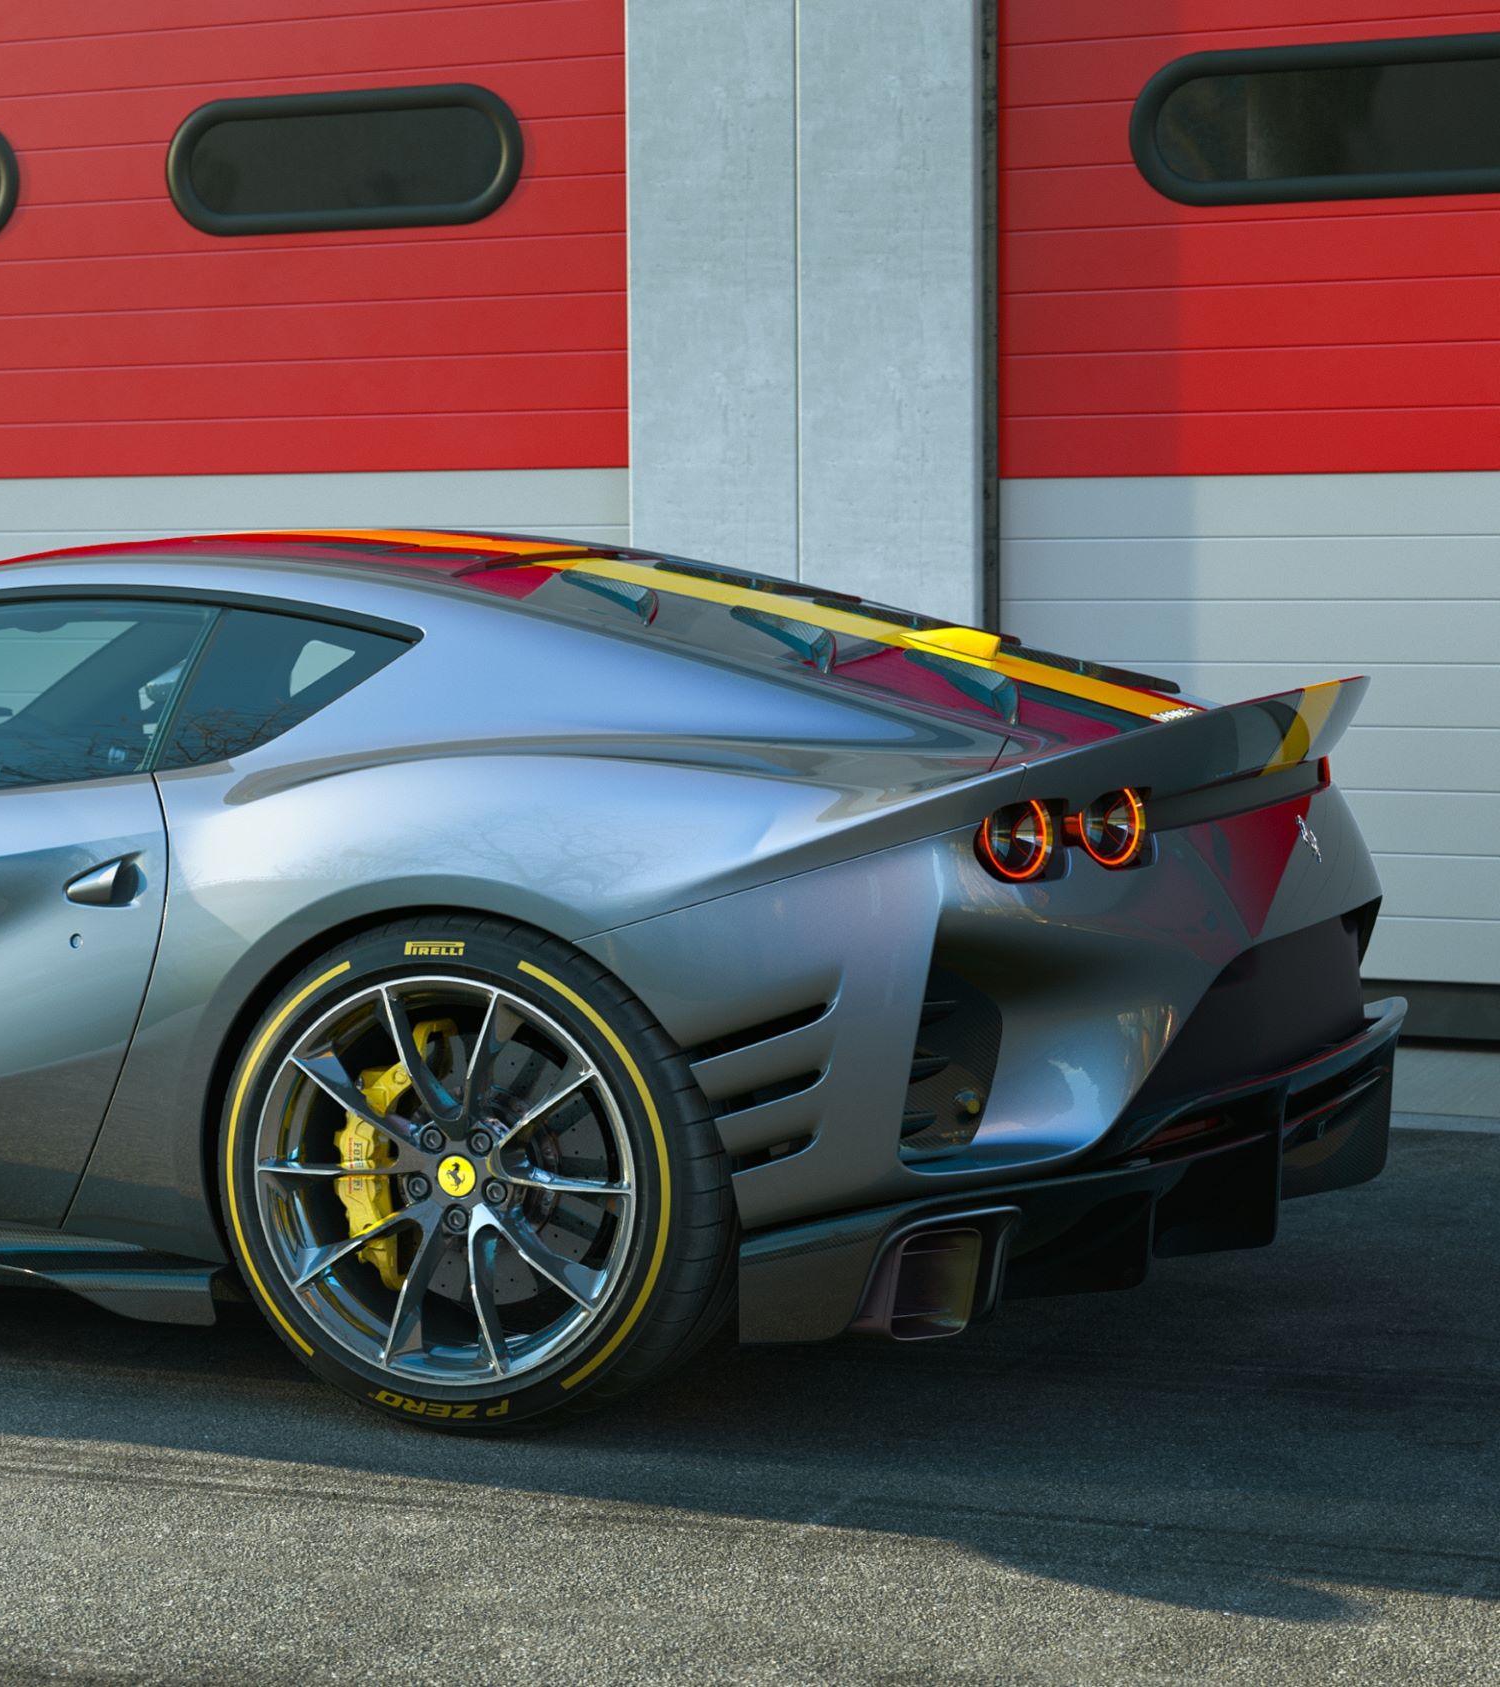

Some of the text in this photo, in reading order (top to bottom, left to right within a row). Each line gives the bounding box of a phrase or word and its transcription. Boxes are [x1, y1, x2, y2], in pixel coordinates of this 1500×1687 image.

[404, 941, 465, 956] PIRELLI
[374, 1389, 510, 1419] P ZERO
